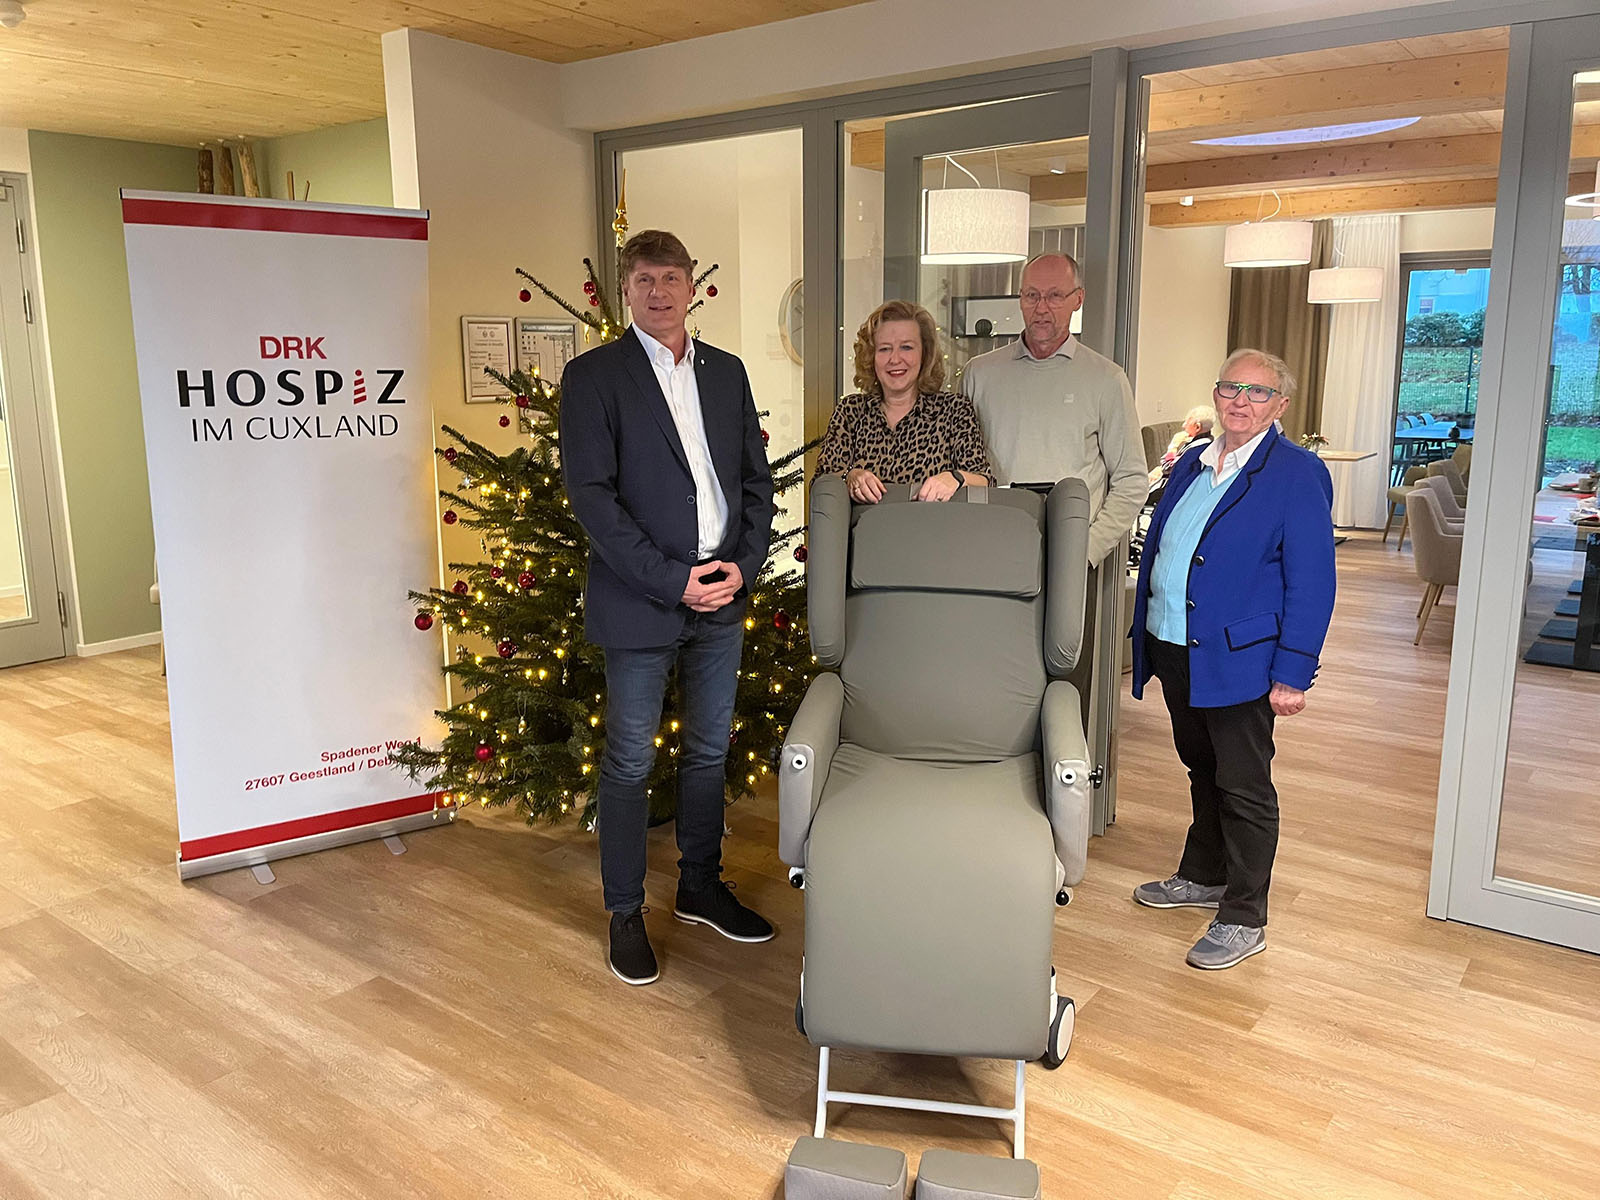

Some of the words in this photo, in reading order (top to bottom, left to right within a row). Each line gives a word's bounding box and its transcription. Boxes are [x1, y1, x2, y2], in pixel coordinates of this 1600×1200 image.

[259, 336, 327, 360] DRK
[192, 418, 233, 442] IM
[246, 414, 399, 440] CUXLAND
[320, 744, 382, 763] Spadener
[245, 774, 285, 791] 27607
[289, 762, 355, 783] Geestland
[359, 759, 364, 771] /
